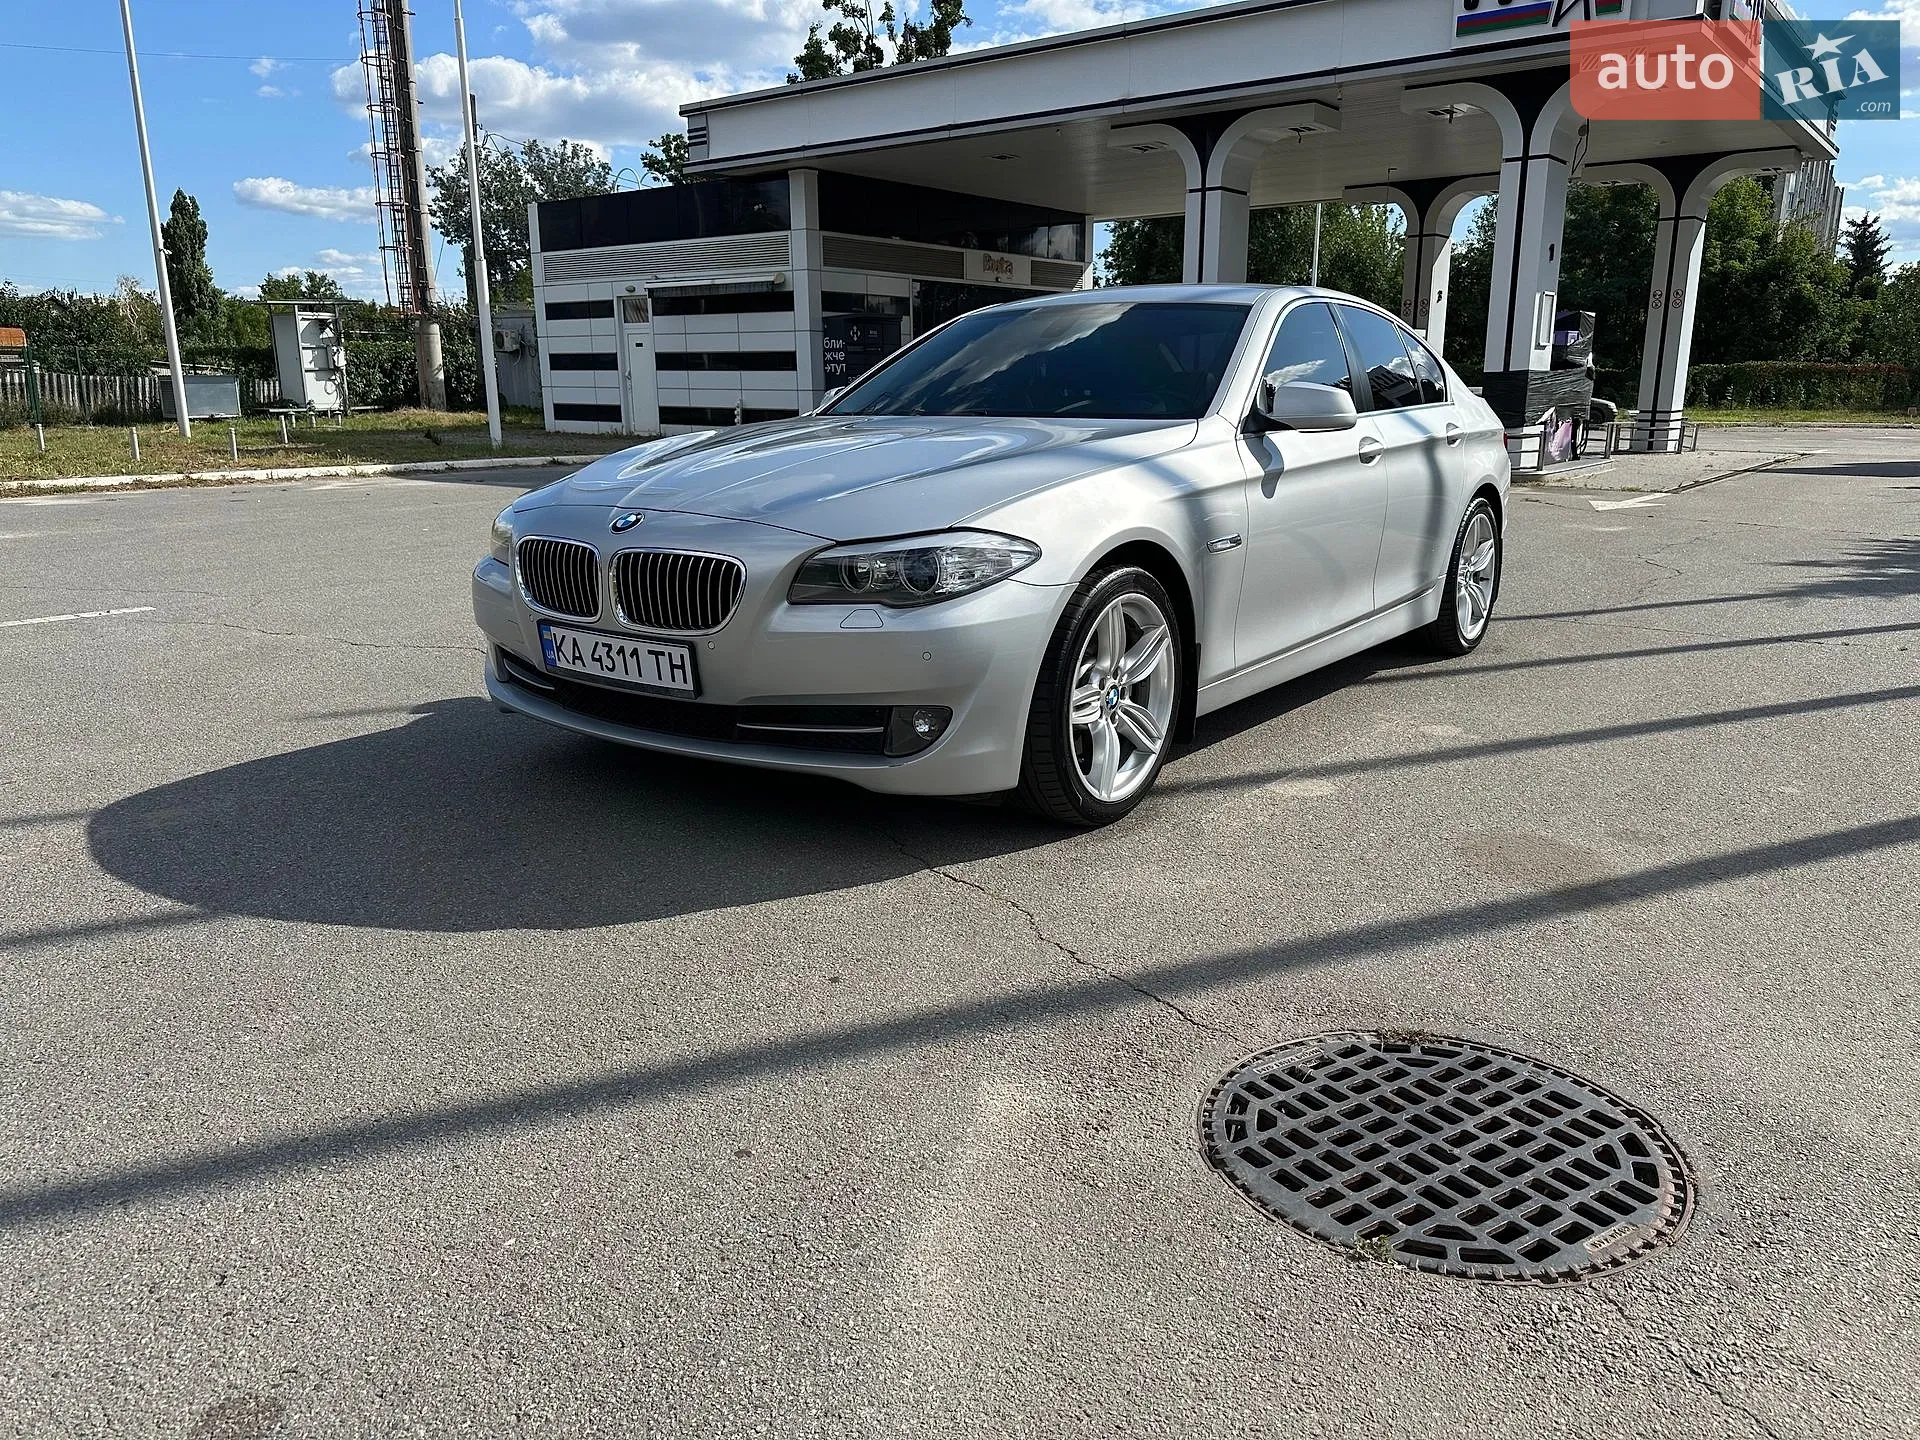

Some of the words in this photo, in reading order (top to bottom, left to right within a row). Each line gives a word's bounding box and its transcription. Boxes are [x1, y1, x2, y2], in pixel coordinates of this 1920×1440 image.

[823, 337, 846, 349] бли-
[824, 351, 846, 361] жче
[553, 632, 586, 667] KA
[591, 641, 642, 678] 4311
[647, 649, 688, 684] TH
